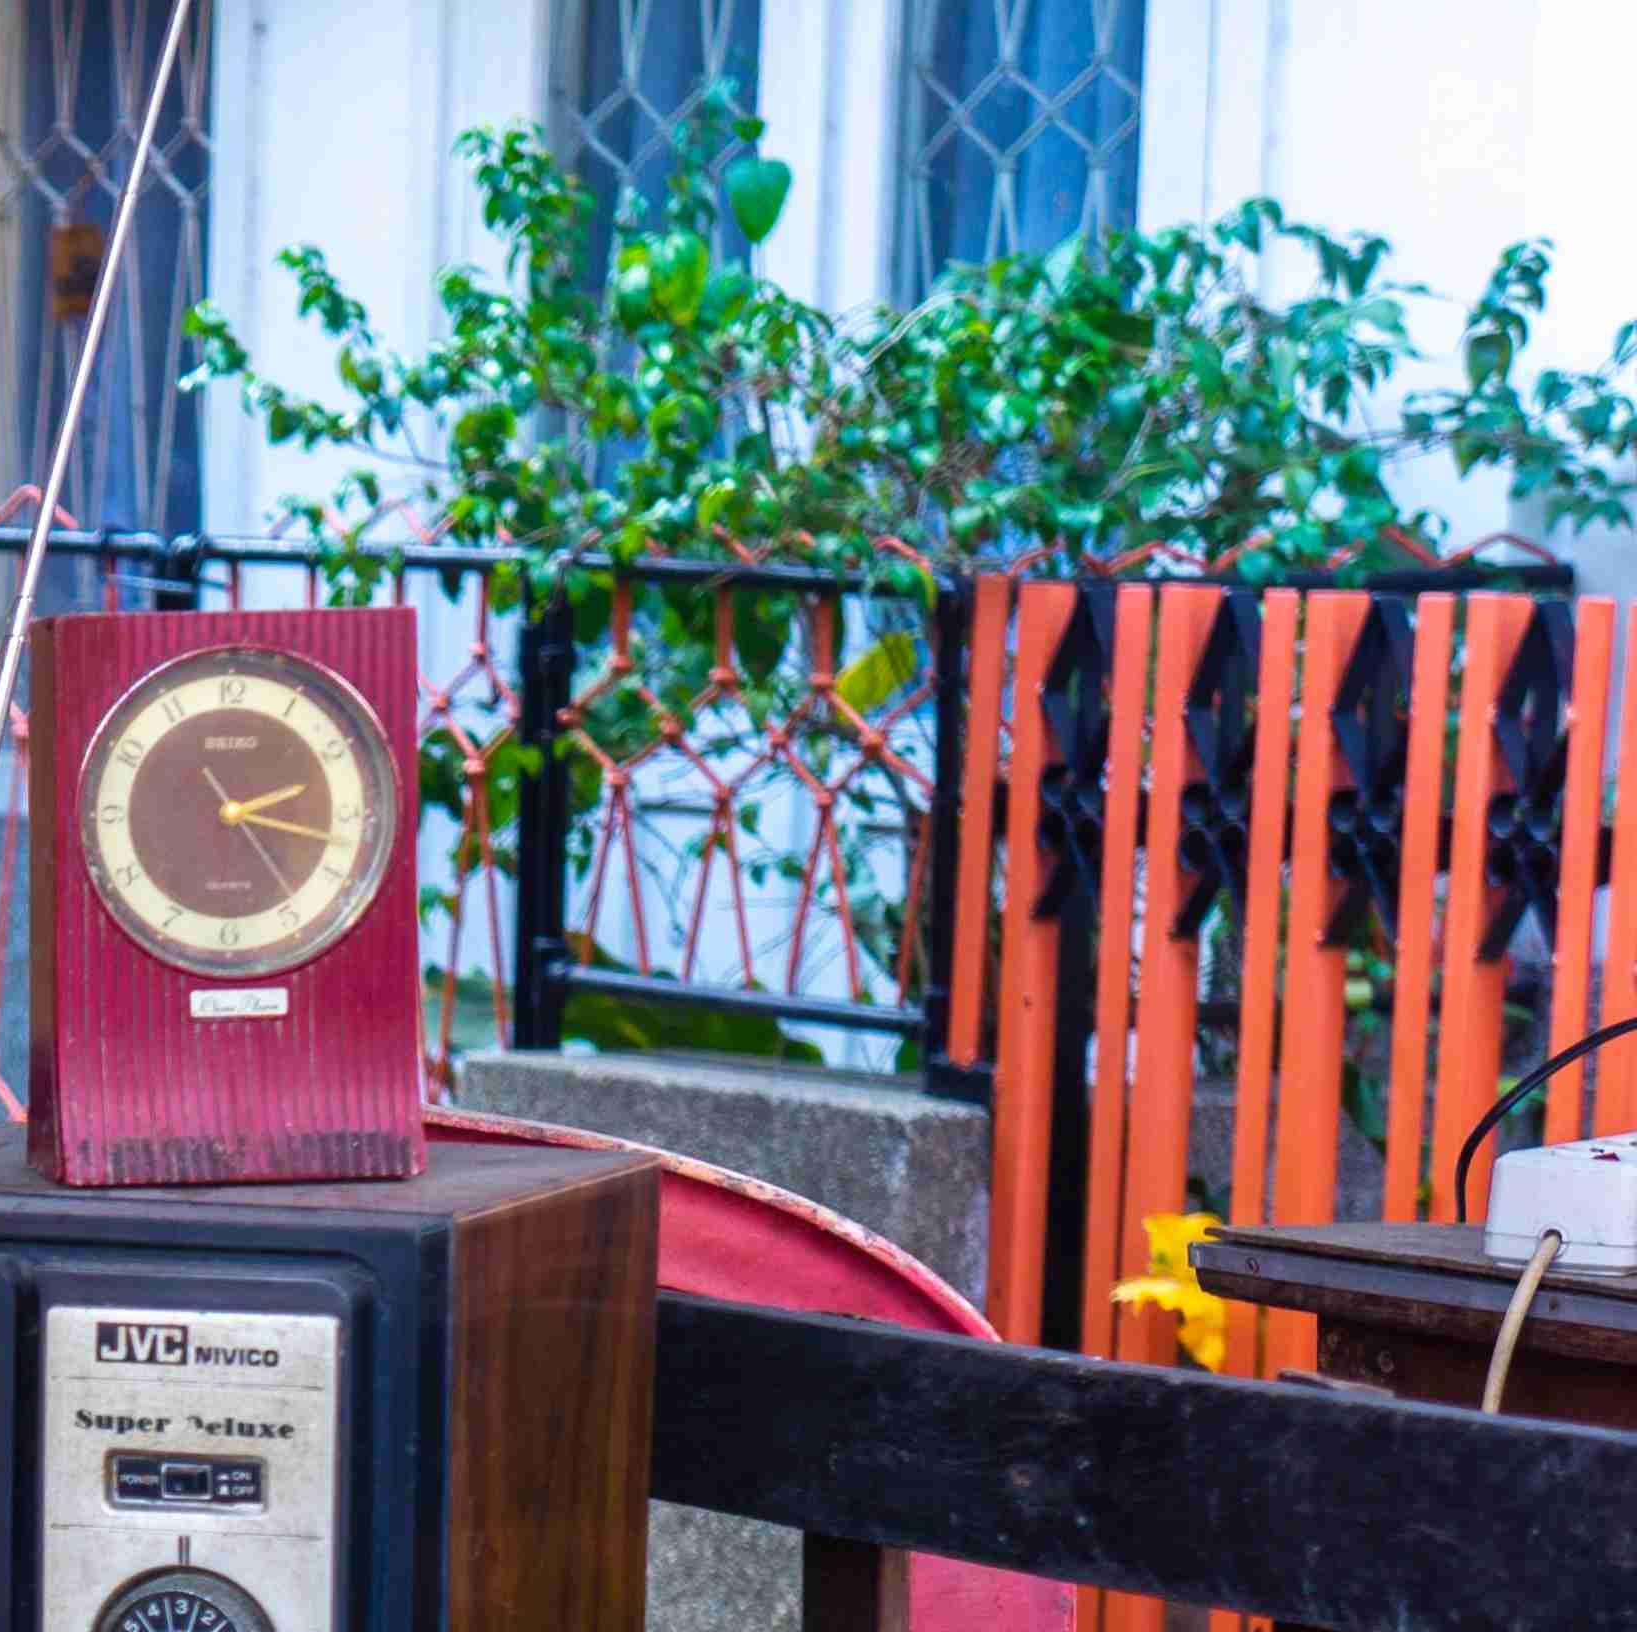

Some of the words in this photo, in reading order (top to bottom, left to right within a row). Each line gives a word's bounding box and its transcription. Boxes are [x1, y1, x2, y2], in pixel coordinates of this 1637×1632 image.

[220, 679, 246, 705] 12
[98, 1324, 187, 1365] JVC
[194, 1345, 280, 1367] NIVICO
[74, 1408, 172, 1434] Super
[175, 1600, 189, 1615] 3
[200, 1609, 217, 1626] 2
